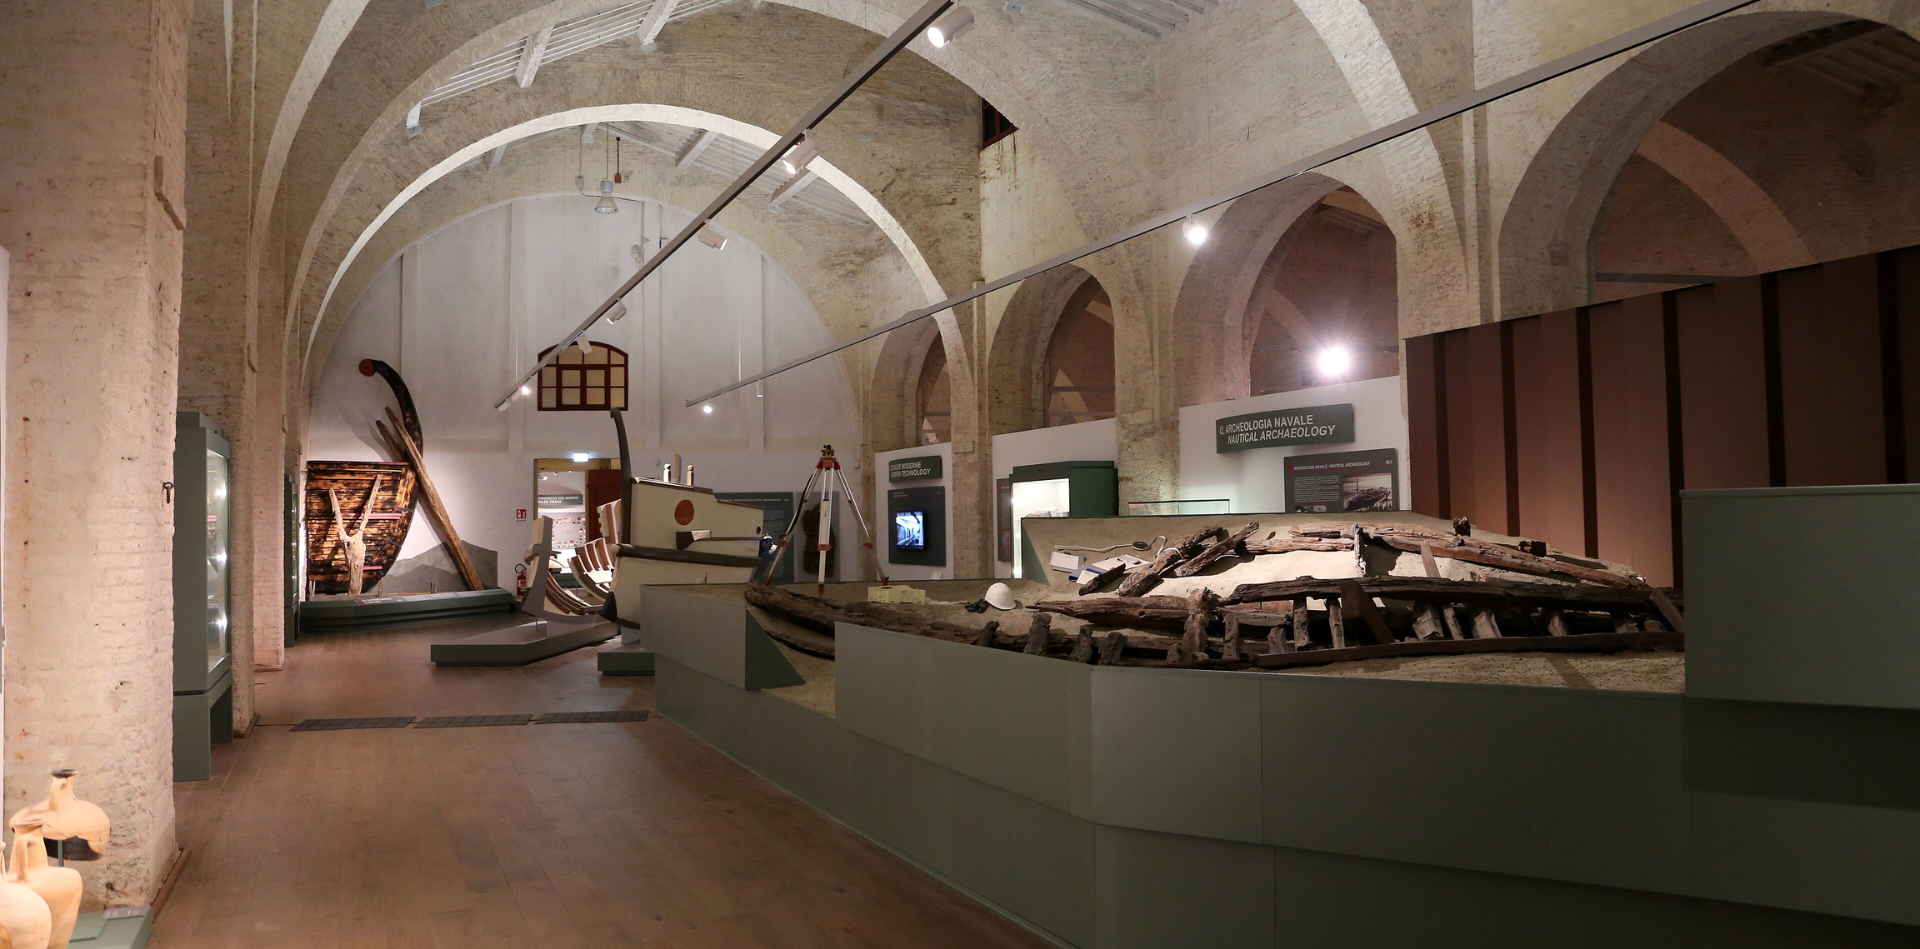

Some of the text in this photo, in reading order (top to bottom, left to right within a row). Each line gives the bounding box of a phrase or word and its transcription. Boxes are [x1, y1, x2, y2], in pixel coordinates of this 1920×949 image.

[1225, 418, 1273, 434] ARCHEOLOGIA
[1274, 414, 1314, 428] NAVALE
[1227, 425, 1336, 444] NAUTICAL ARCHAEOLOGY
[902, 468, 930, 477] TECHNOLOGY
